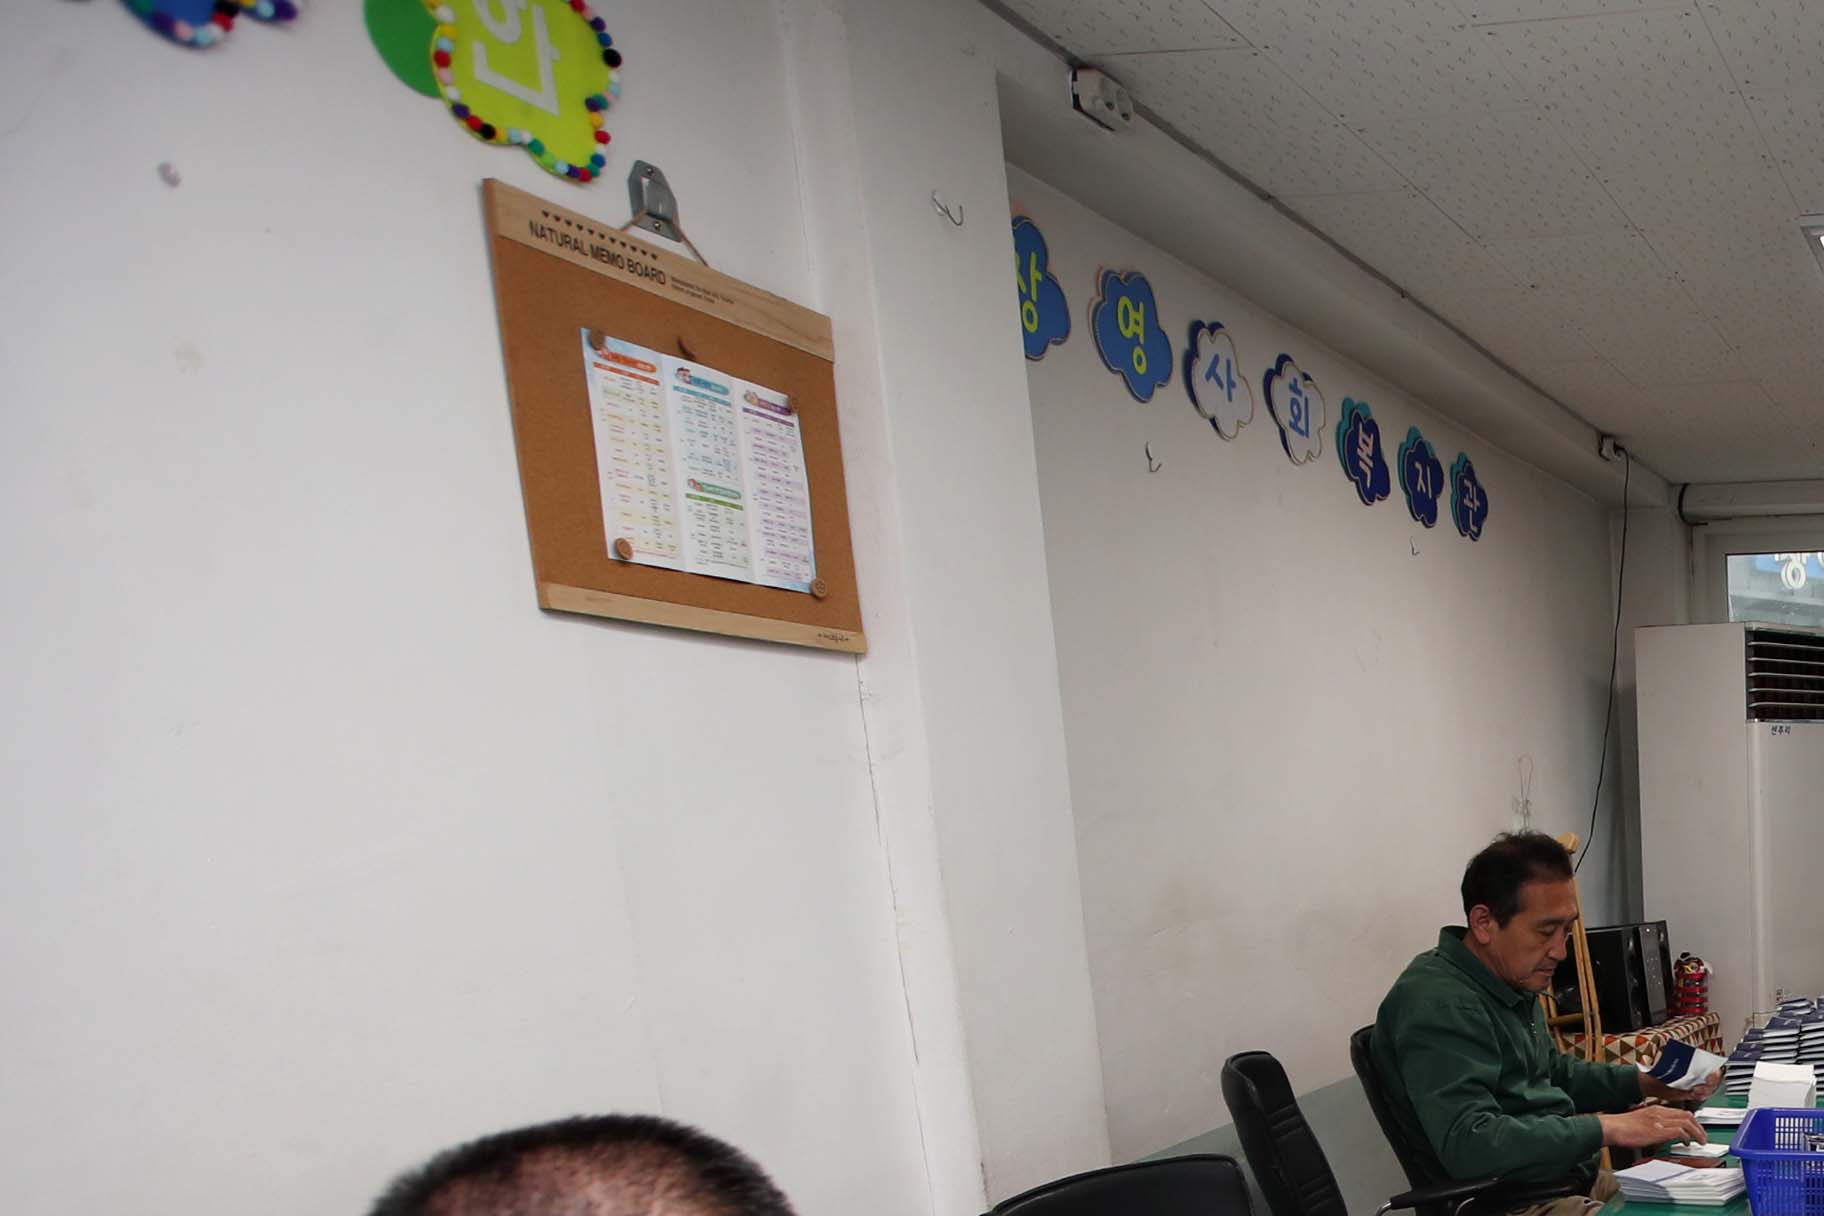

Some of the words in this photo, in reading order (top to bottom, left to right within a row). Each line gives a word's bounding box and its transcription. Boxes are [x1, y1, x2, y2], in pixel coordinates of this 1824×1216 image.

[528, 219, 589, 257] NATURAL
[589, 243, 625, 270] MEMO
[626, 258, 667, 286] BOARD
